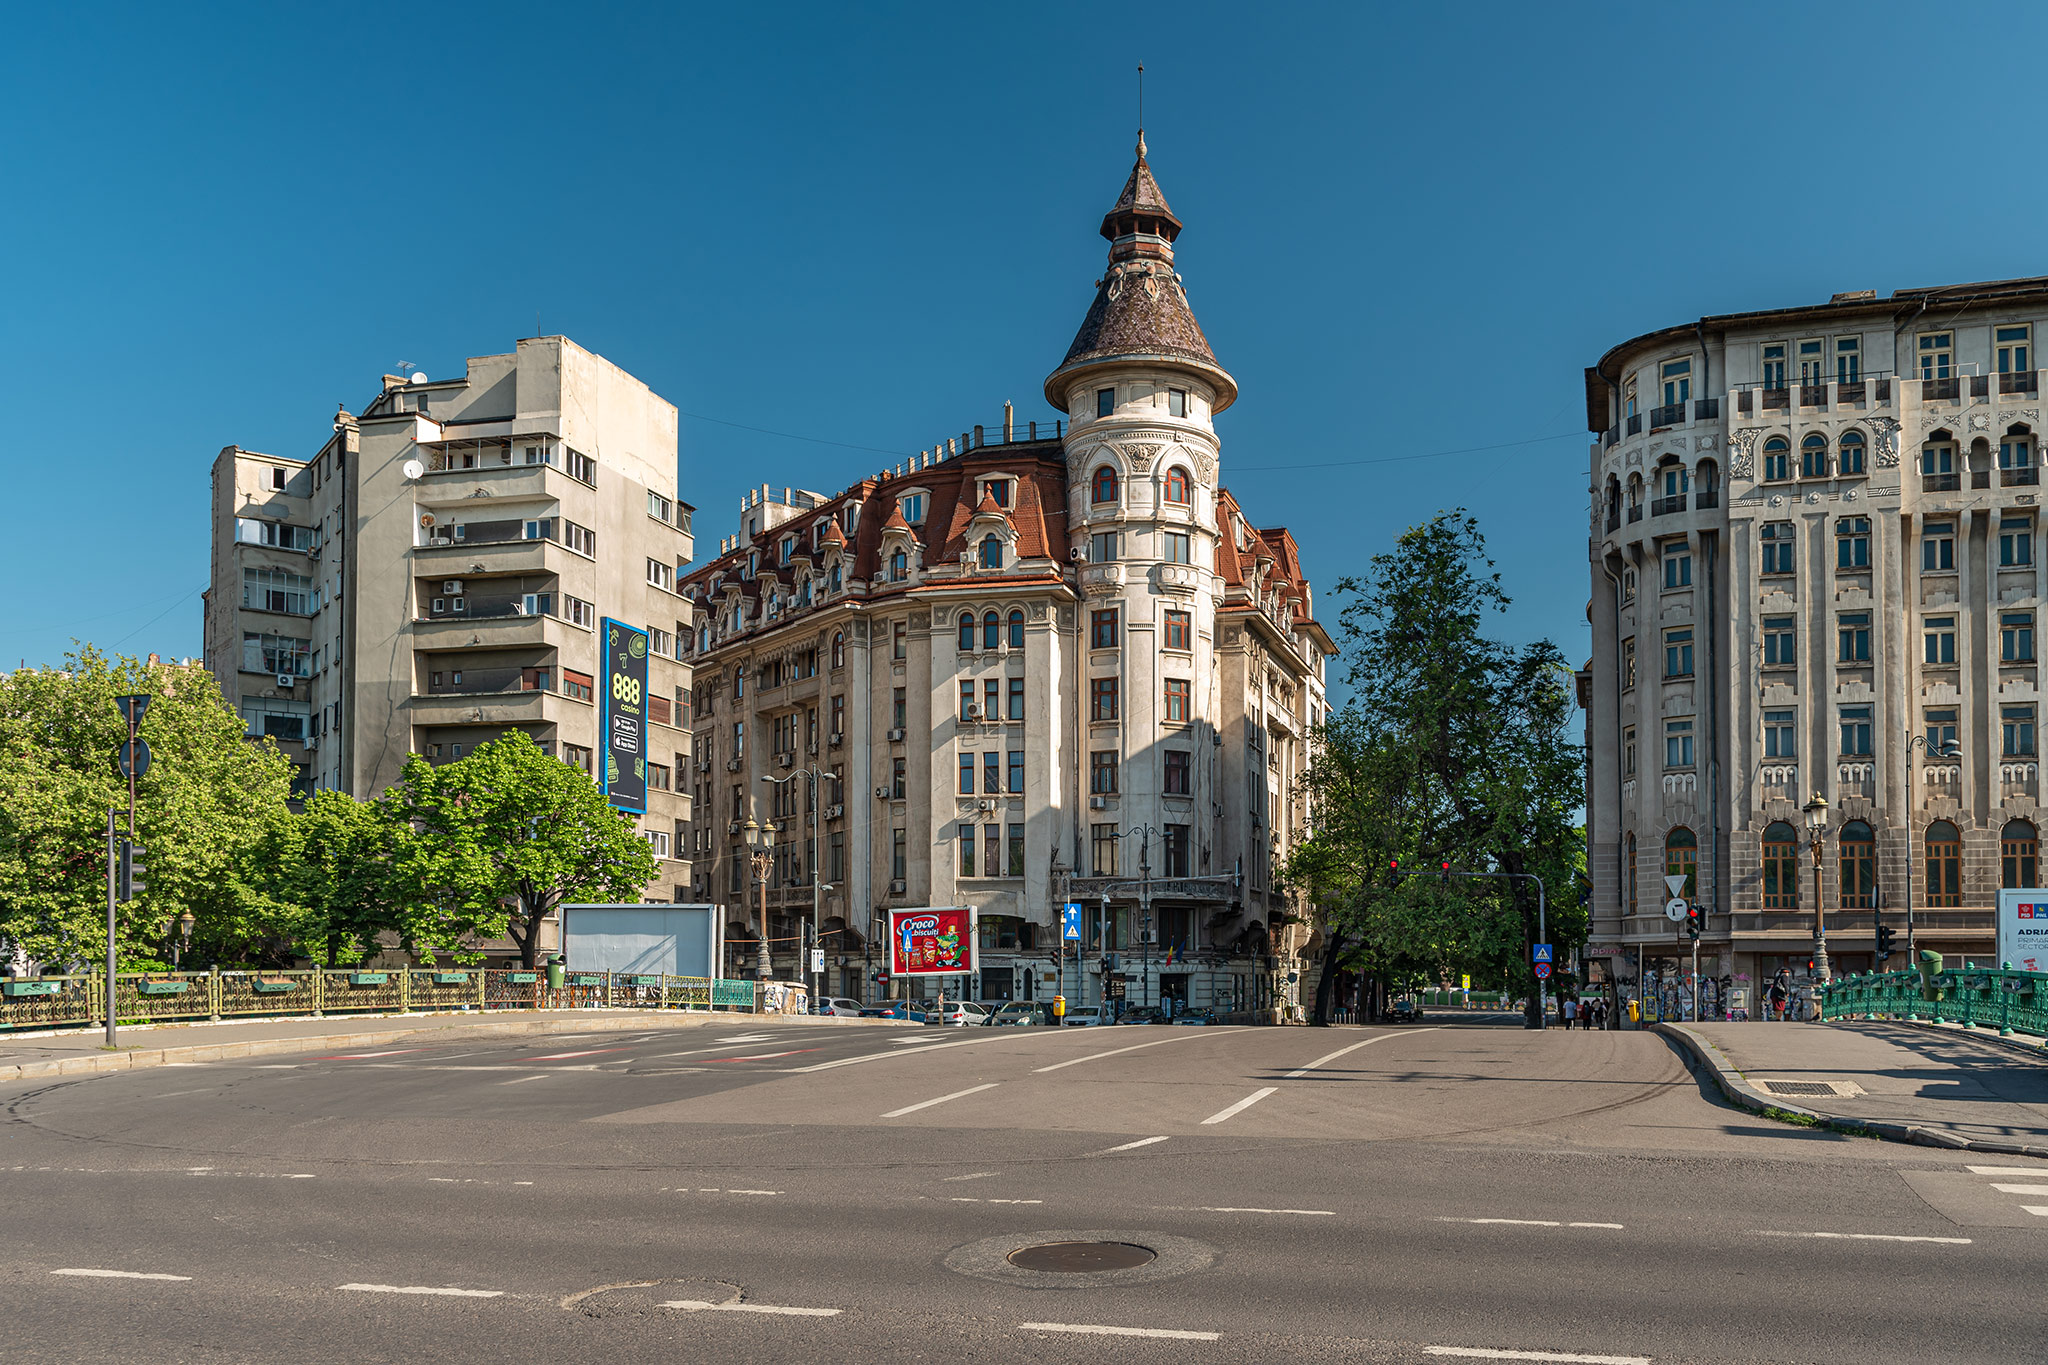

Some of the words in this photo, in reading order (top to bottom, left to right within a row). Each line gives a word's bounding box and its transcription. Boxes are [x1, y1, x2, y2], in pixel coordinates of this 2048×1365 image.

[613, 672, 640, 705] 888
[621, 704, 640, 715] casino
[901, 918, 935, 931] Croco
